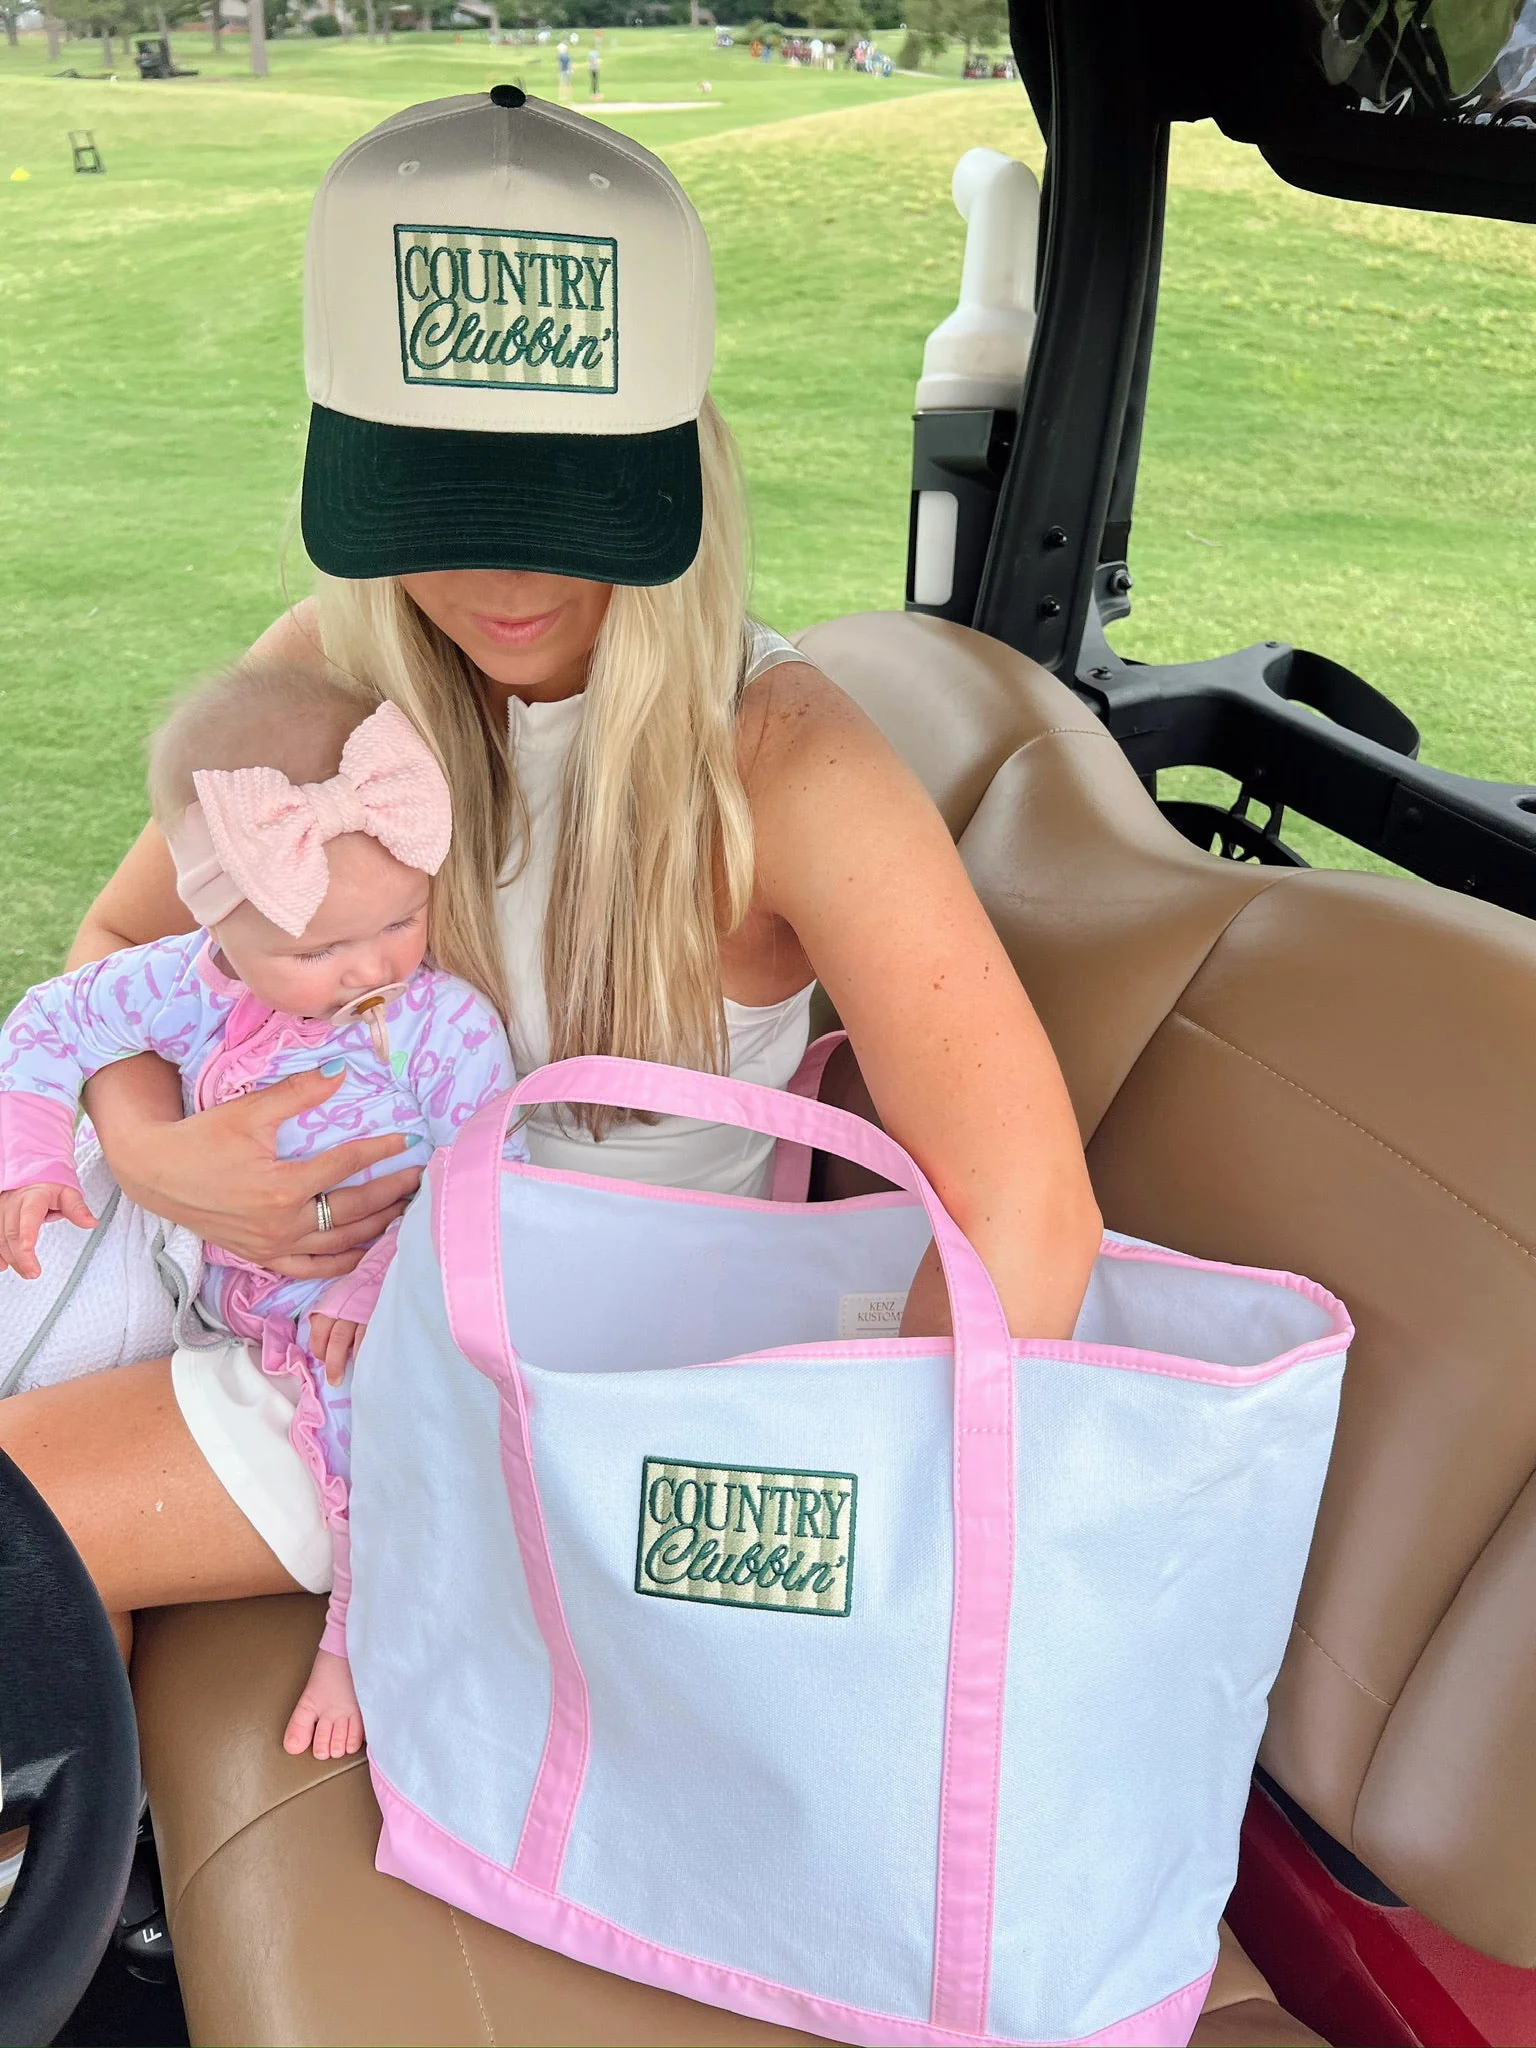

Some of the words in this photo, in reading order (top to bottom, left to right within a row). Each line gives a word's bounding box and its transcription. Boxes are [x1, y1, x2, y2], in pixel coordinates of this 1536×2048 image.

[405, 245, 612, 311] COUNTRY
[410, 299, 612, 370] Clubbin'
[857, 1312, 904, 1322] KUSTOM
[869, 1301, 896, 1312] KENZ
[648, 1476, 851, 1540] COUNTRY
[645, 1524, 846, 1593] Clubbin'
[142, 1928, 162, 1944] F
